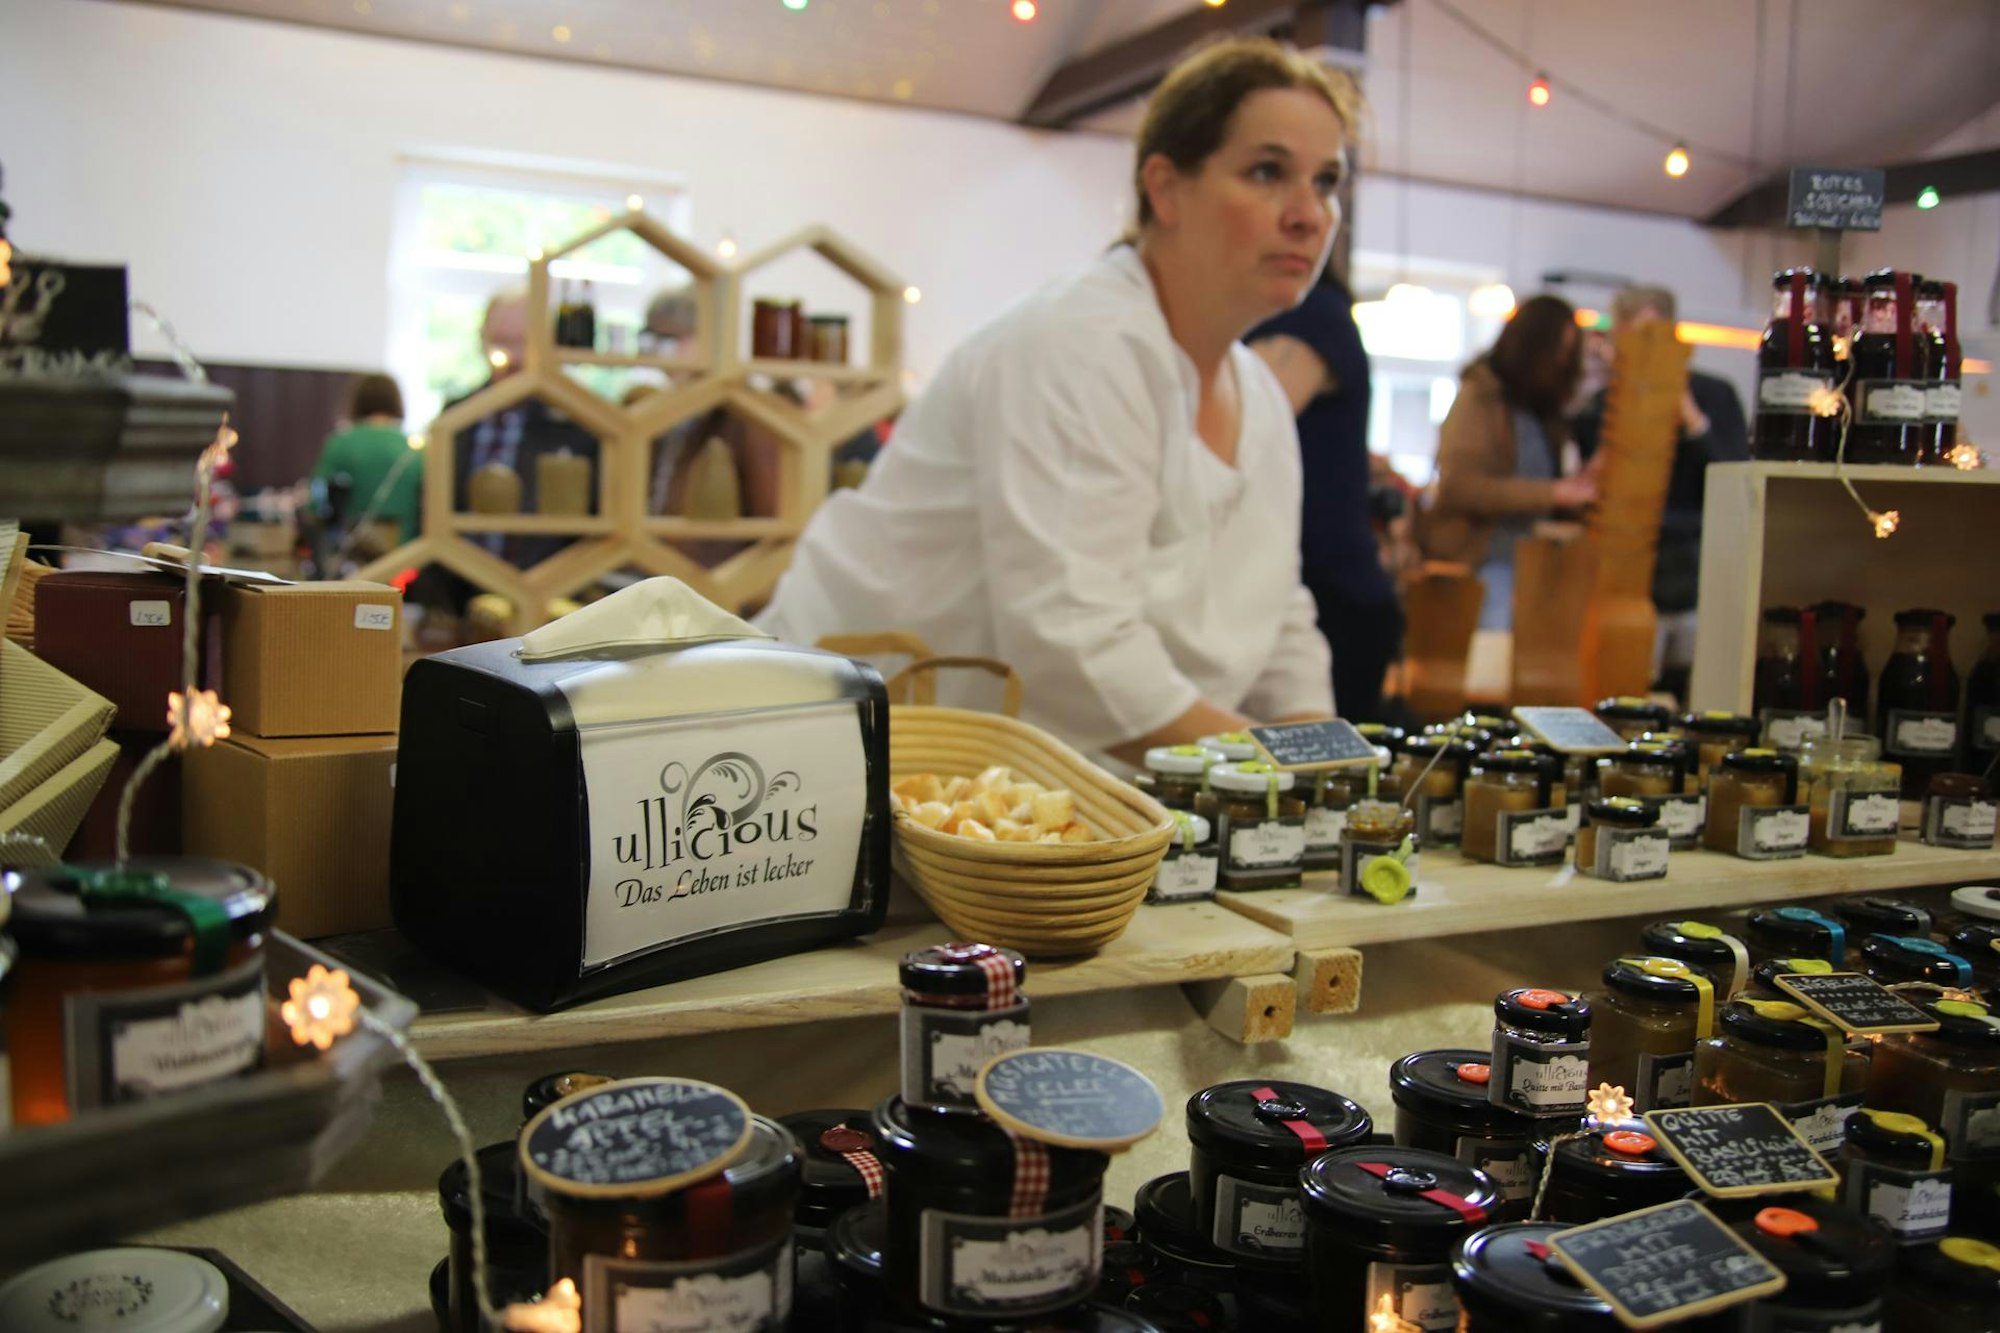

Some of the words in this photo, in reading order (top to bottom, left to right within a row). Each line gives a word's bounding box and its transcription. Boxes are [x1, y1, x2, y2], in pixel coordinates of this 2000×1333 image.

[615, 878, 662, 908] Das
[667, 868, 730, 903] Leben
[735, 863, 759, 886] ist
[763, 853, 814, 882] lecker
